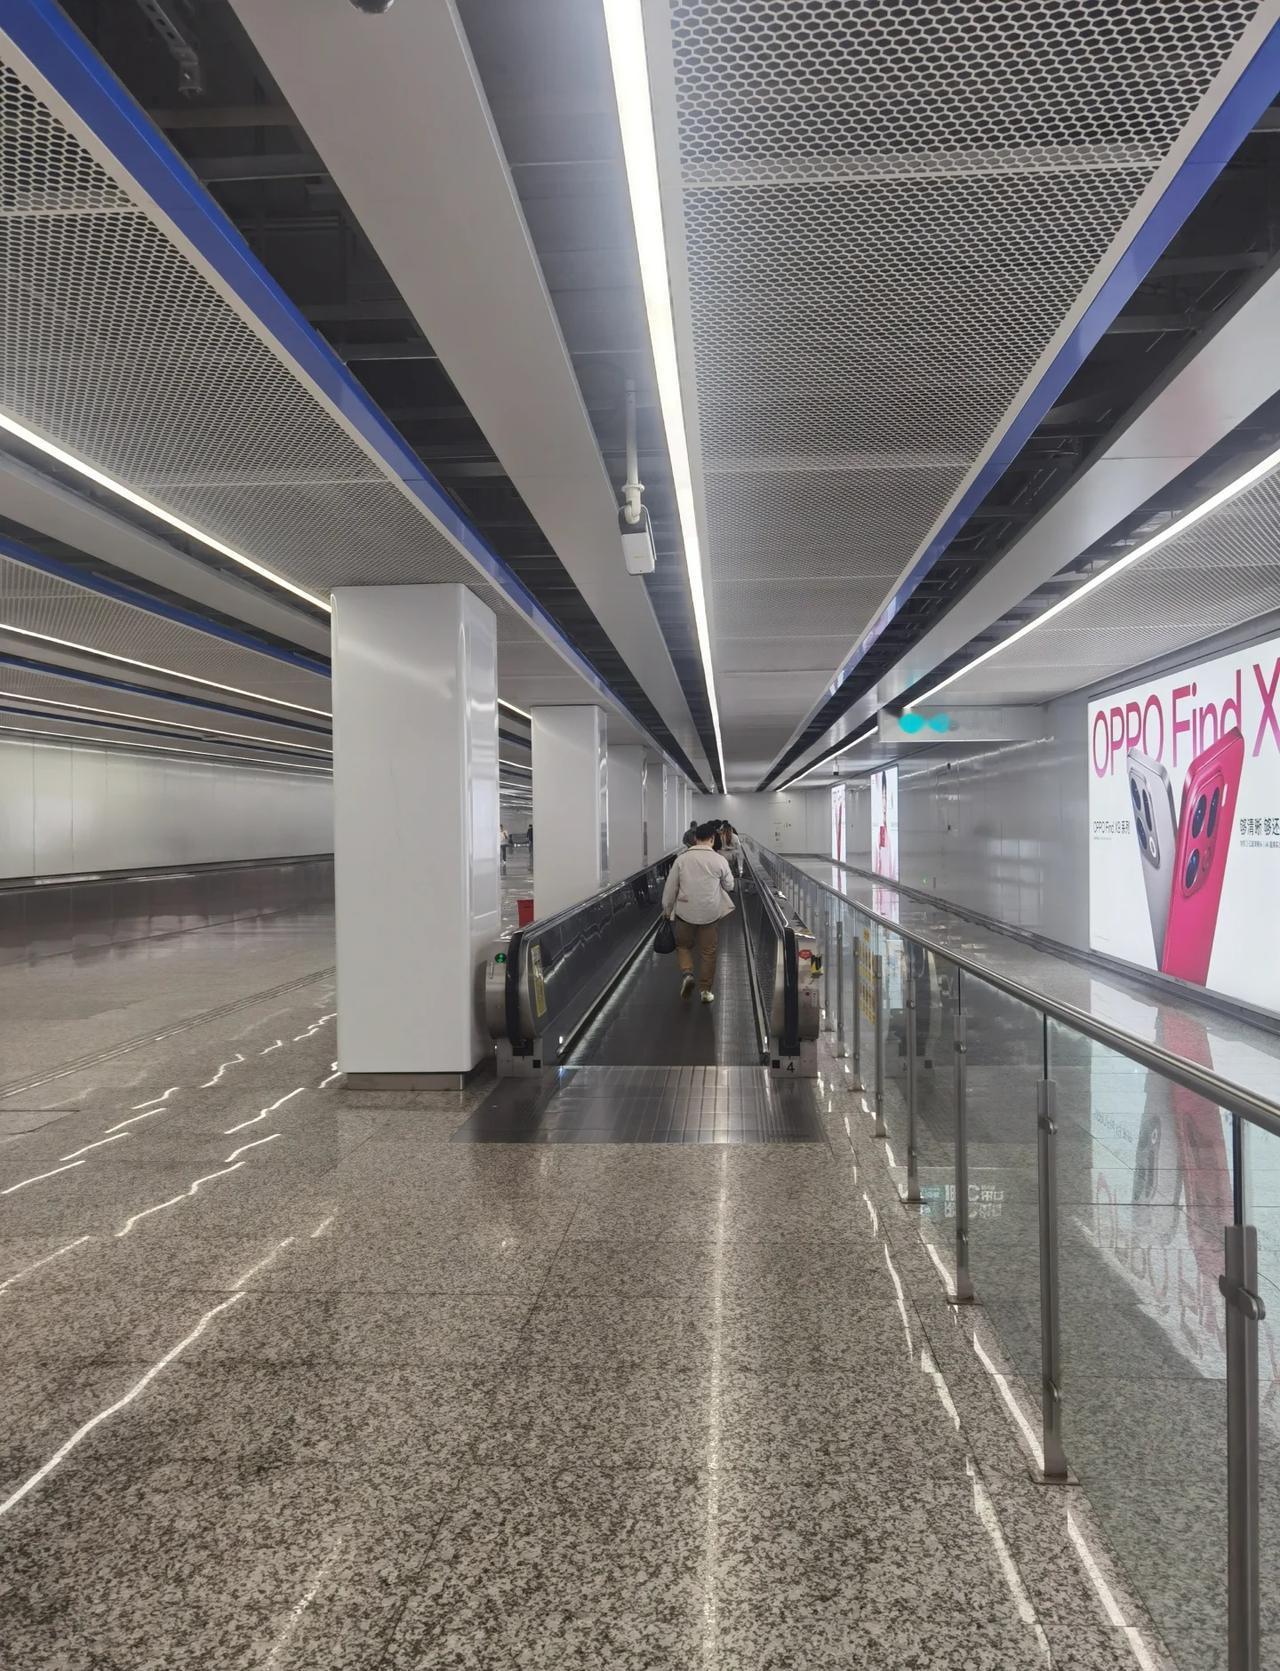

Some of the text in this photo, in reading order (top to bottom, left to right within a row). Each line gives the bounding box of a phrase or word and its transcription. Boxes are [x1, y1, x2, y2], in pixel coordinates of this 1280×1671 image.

[1093, 694, 1164, 778] OPPO
[1172, 669, 1241, 768] Find
[786, 1062, 795, 1073] 4
